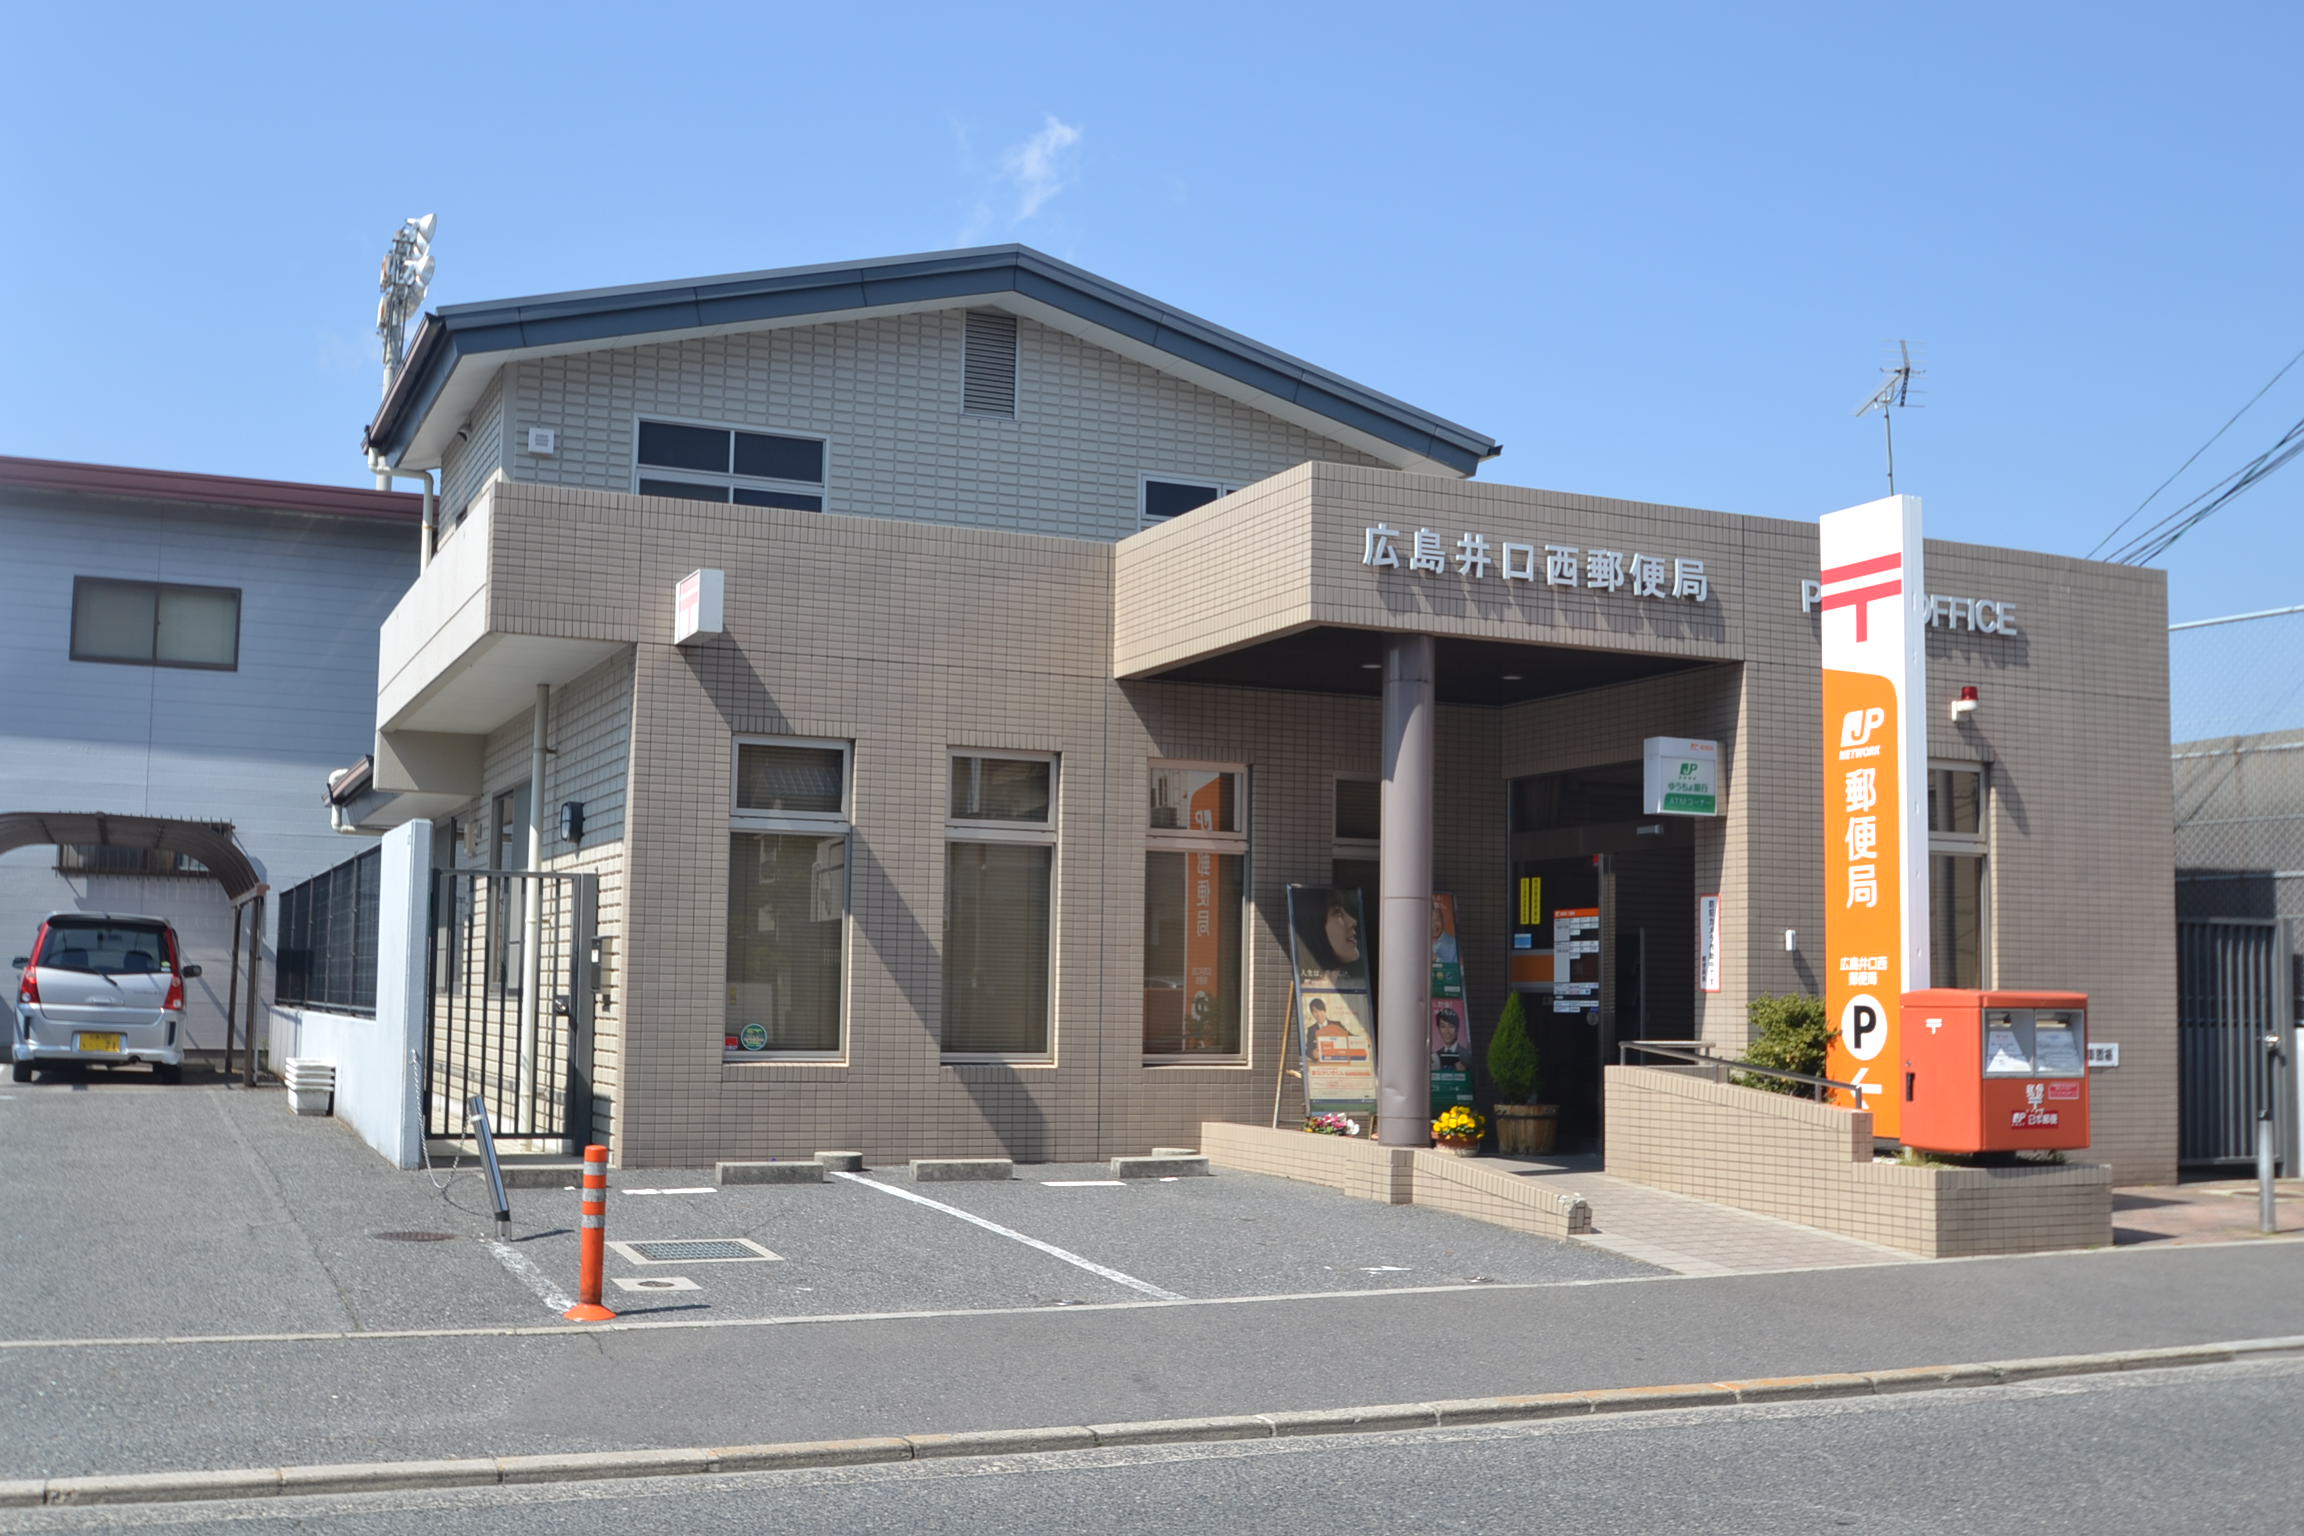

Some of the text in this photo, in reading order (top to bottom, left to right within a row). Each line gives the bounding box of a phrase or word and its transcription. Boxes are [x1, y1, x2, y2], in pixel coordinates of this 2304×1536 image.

[1362, 522, 1708, 602] 広島井口西郵便局
[1840, 706, 1885, 748] JP
[1838, 745, 1880, 761] NETWORK
[1844, 767, 1878, 910] 郵便局
[1840, 956, 1888, 971] 広島井口西
[1848, 971, 1878, 986] 郵便局
[1853, 1005, 1877, 1049] P
